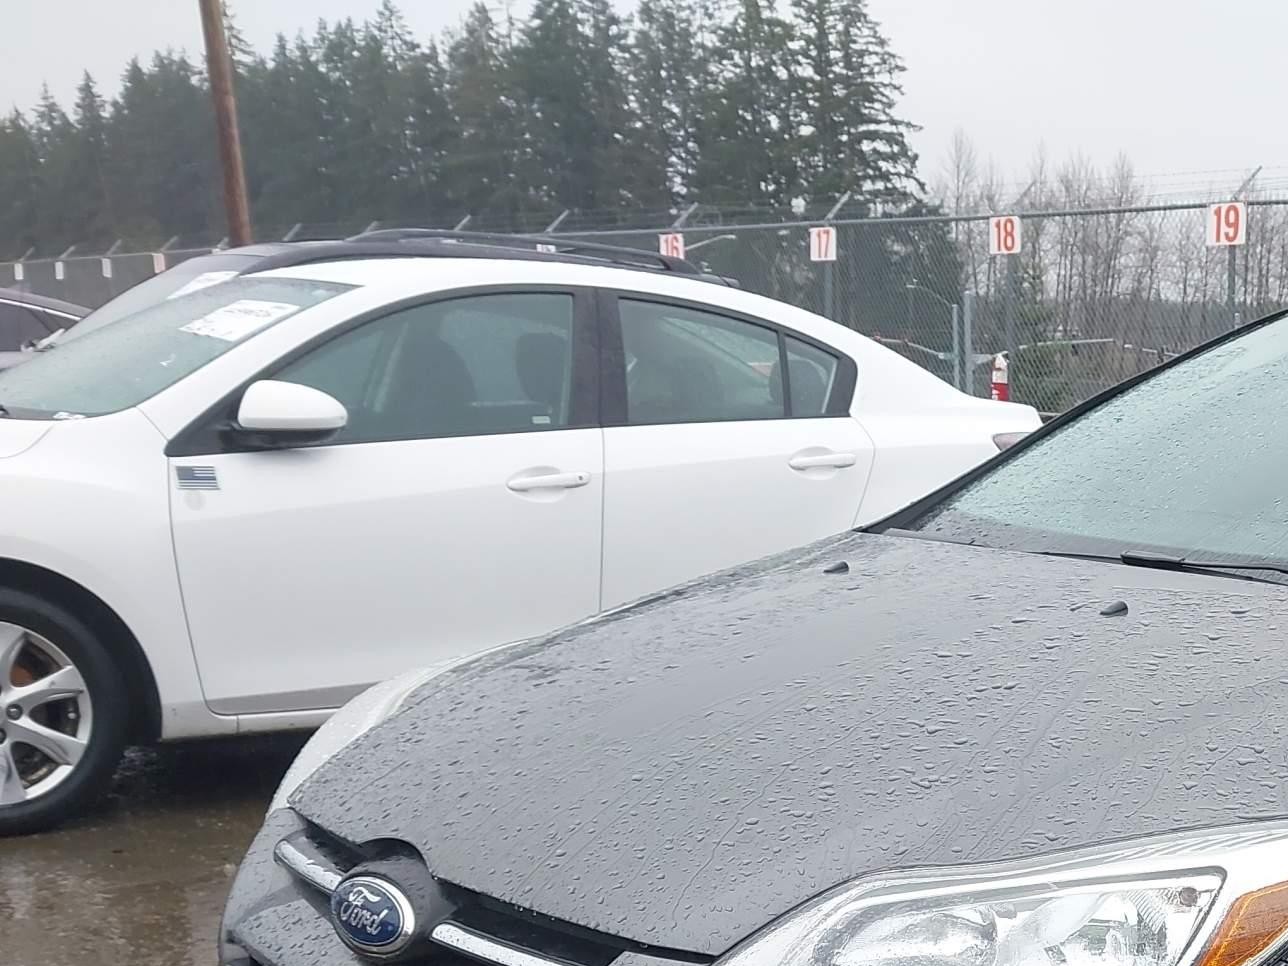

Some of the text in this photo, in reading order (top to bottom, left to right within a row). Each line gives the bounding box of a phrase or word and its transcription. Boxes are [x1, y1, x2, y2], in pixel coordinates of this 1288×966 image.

[994, 218, 1015, 252] 18
[1213, 205, 1240, 243] 19
[663, 236, 681, 257] 16
[816, 229, 831, 259] 17
[340, 886, 389, 935] Ford
